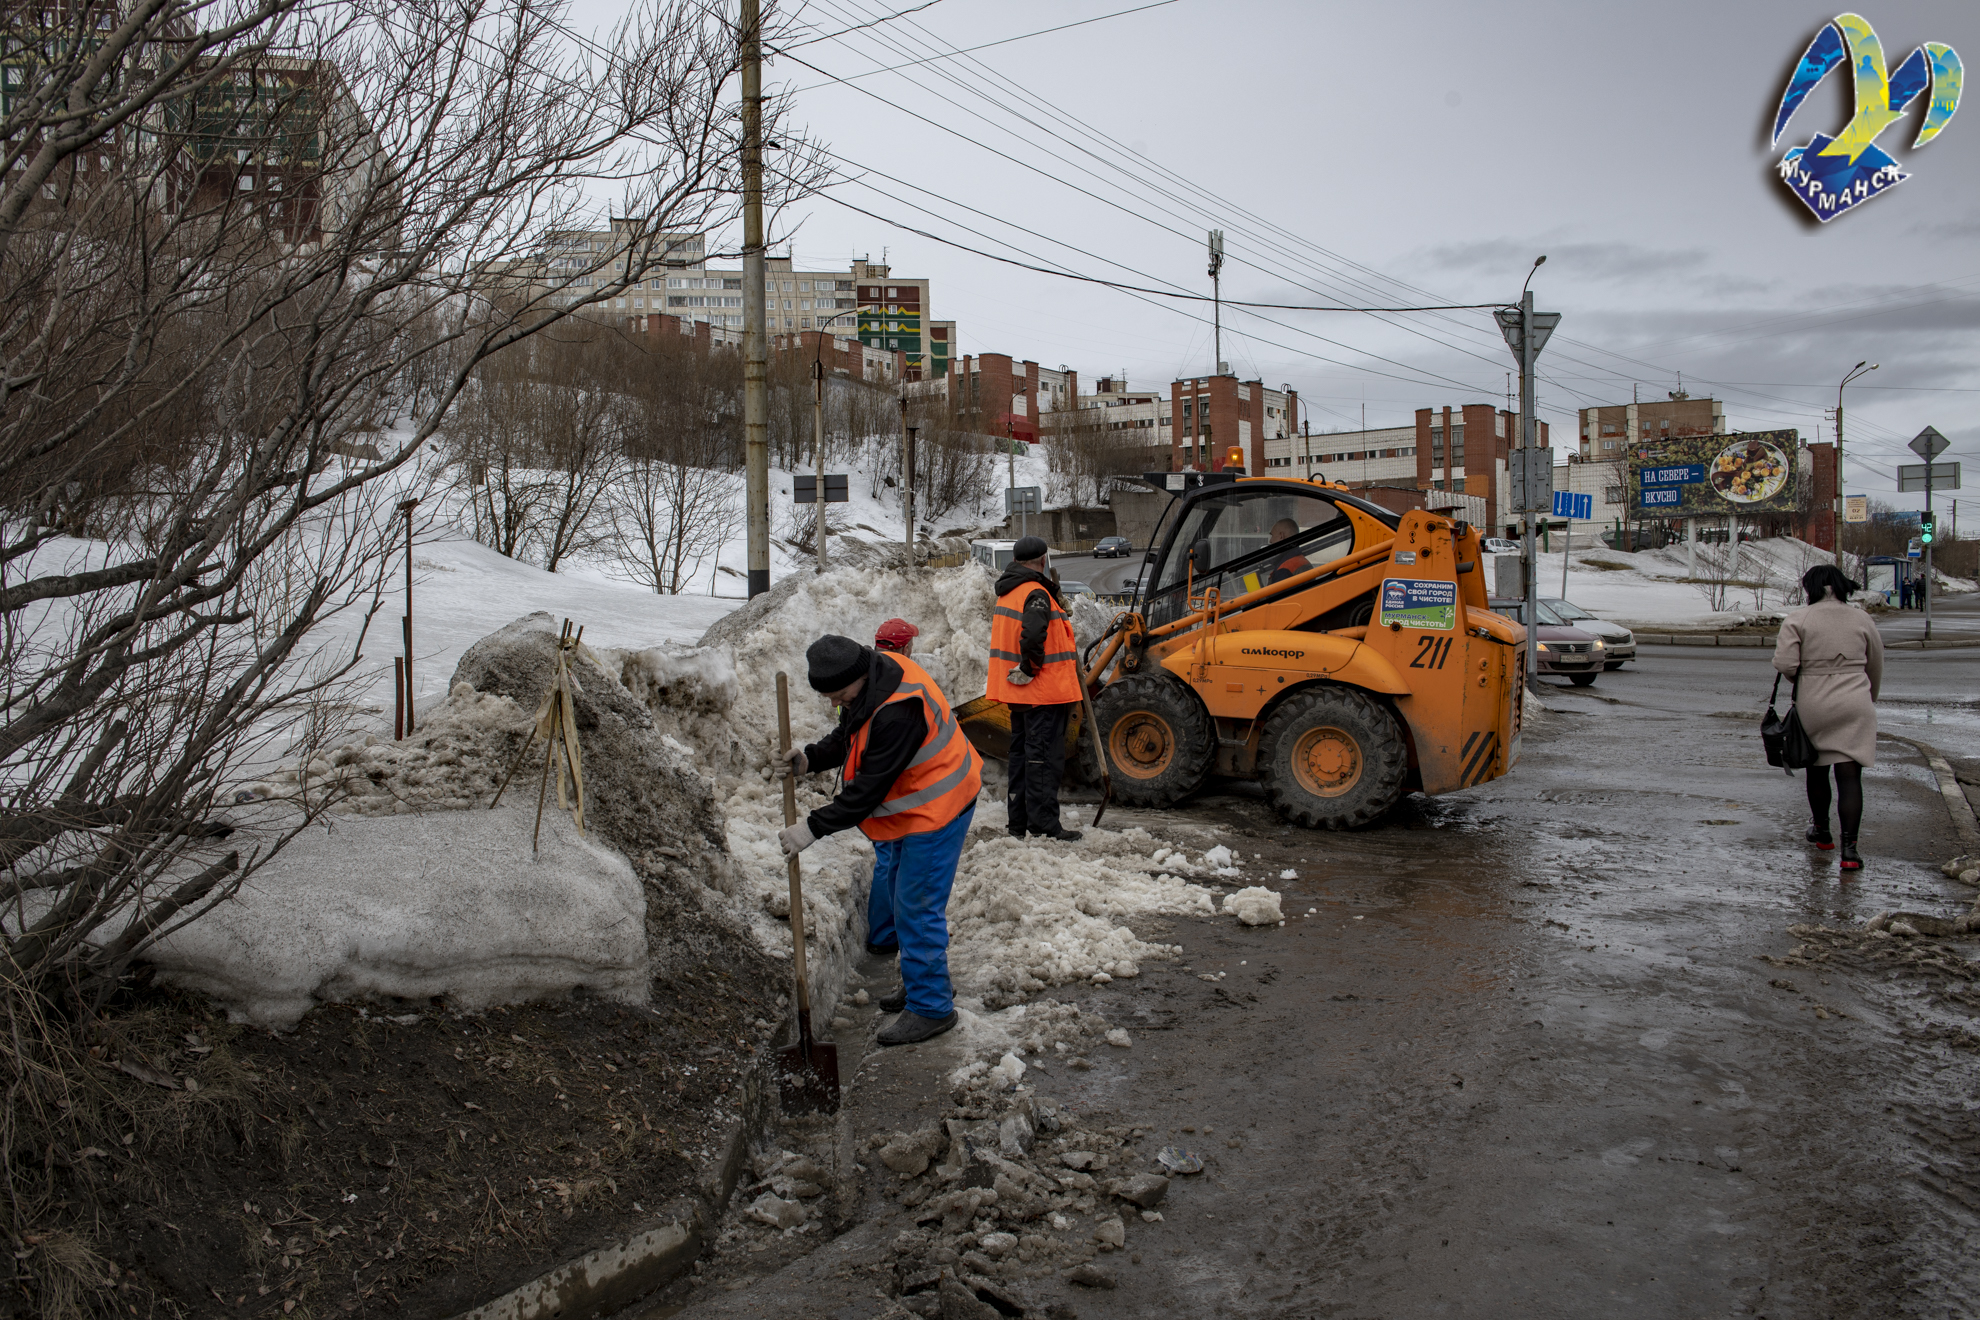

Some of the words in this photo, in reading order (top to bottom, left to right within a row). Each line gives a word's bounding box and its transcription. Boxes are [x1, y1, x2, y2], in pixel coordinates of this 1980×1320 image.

[1644, 471, 1656, 483] НА
[1658, 468, 1689, 482] СЕВЕРЕ
[1645, 490, 1677, 504] ВКУСНО
[1921, 522, 1932, 533] 42
[1414, 582, 1453, 590] СОХРАНИМ
[1410, 620, 1446, 628] ЧИСТОТЫ
[1409, 635, 1454, 669] 211
